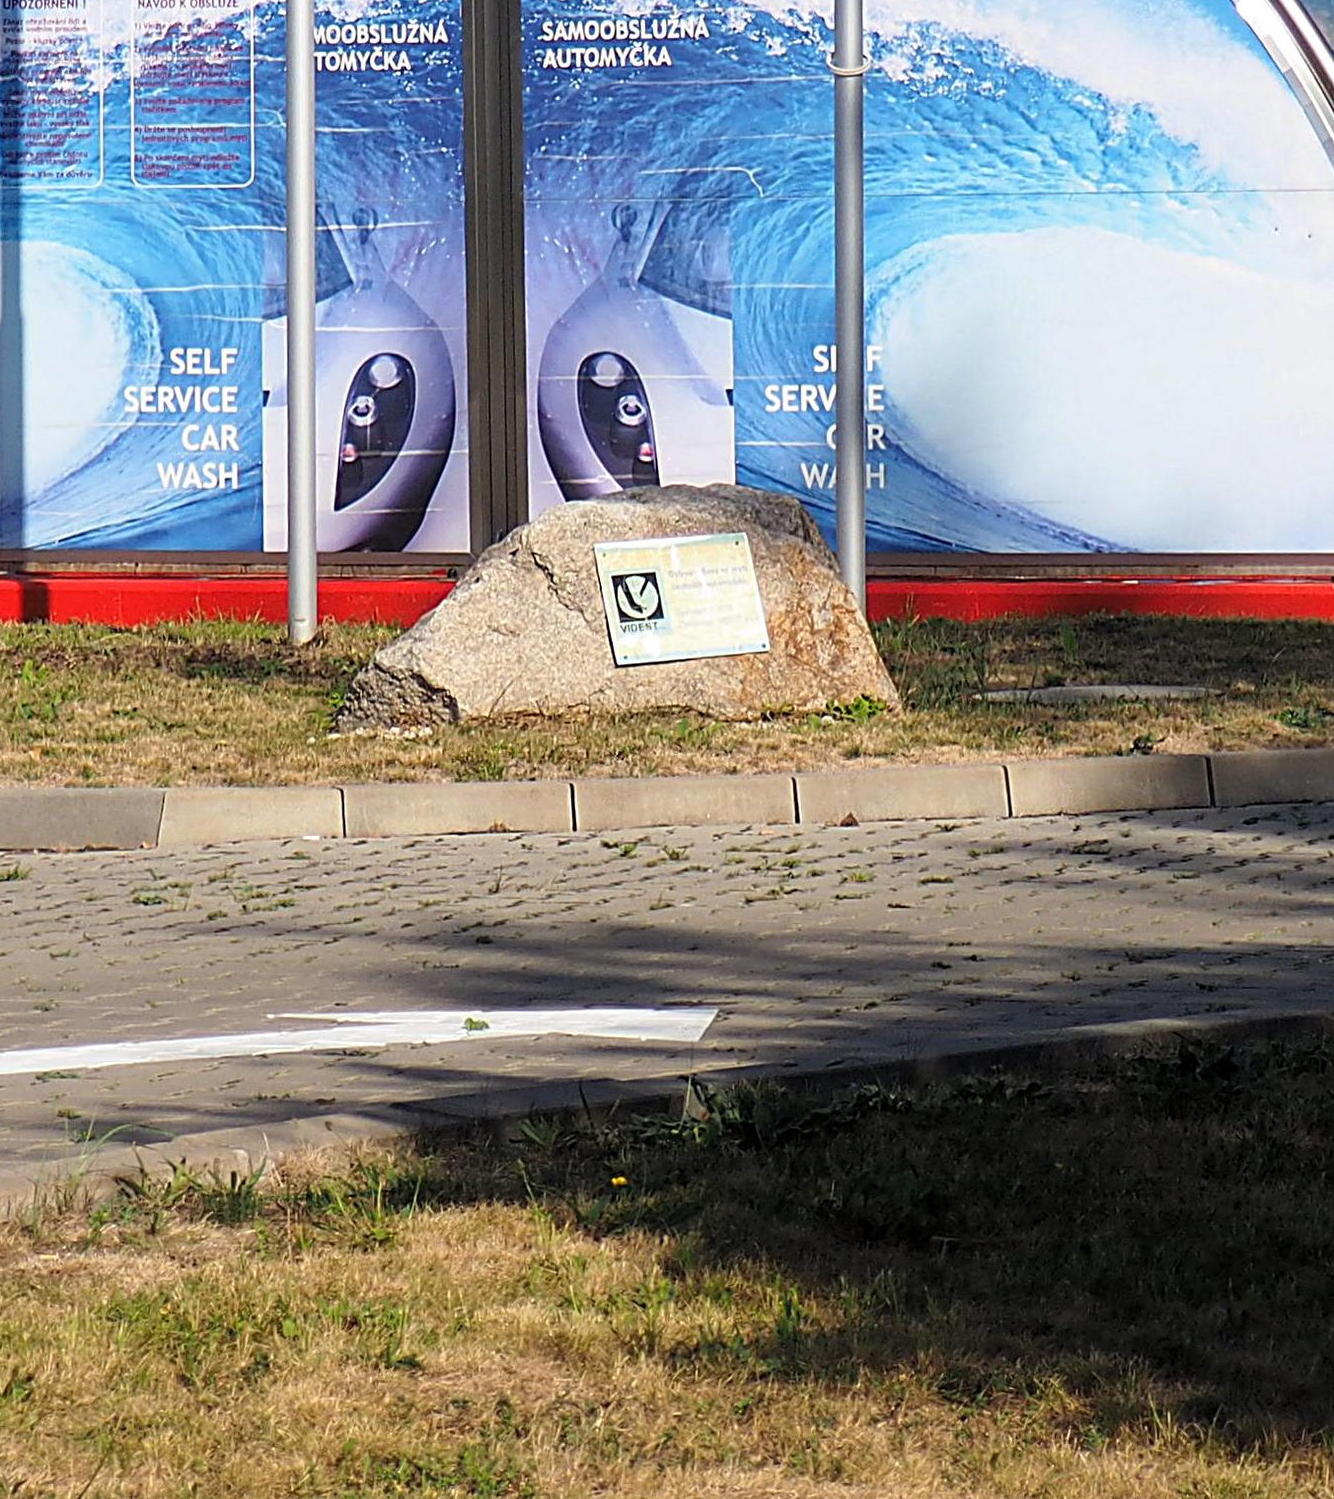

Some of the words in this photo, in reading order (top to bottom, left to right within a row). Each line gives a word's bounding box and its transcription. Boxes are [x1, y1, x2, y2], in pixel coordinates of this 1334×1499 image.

[314, 19, 449, 45] MOOBSLUŽNÁ
[542, 14, 709, 42] SAMOOBSLUŽNÁ
[314, 47, 412, 72] TOMYČKA
[543, 42, 673, 69] AUTOMYČKA
[170, 348, 238, 375] SELF
[813, 345, 884, 373] SF
[123, 386, 238, 413] SERVICE
[765, 384, 885, 412] SERVE
[182, 424, 240, 451] CAR
[826, 423, 886, 451] CR
[157, 462, 239, 490] WASH
[800, 463, 885, 489] WH
[619, 621, 660, 634] VIDENT
